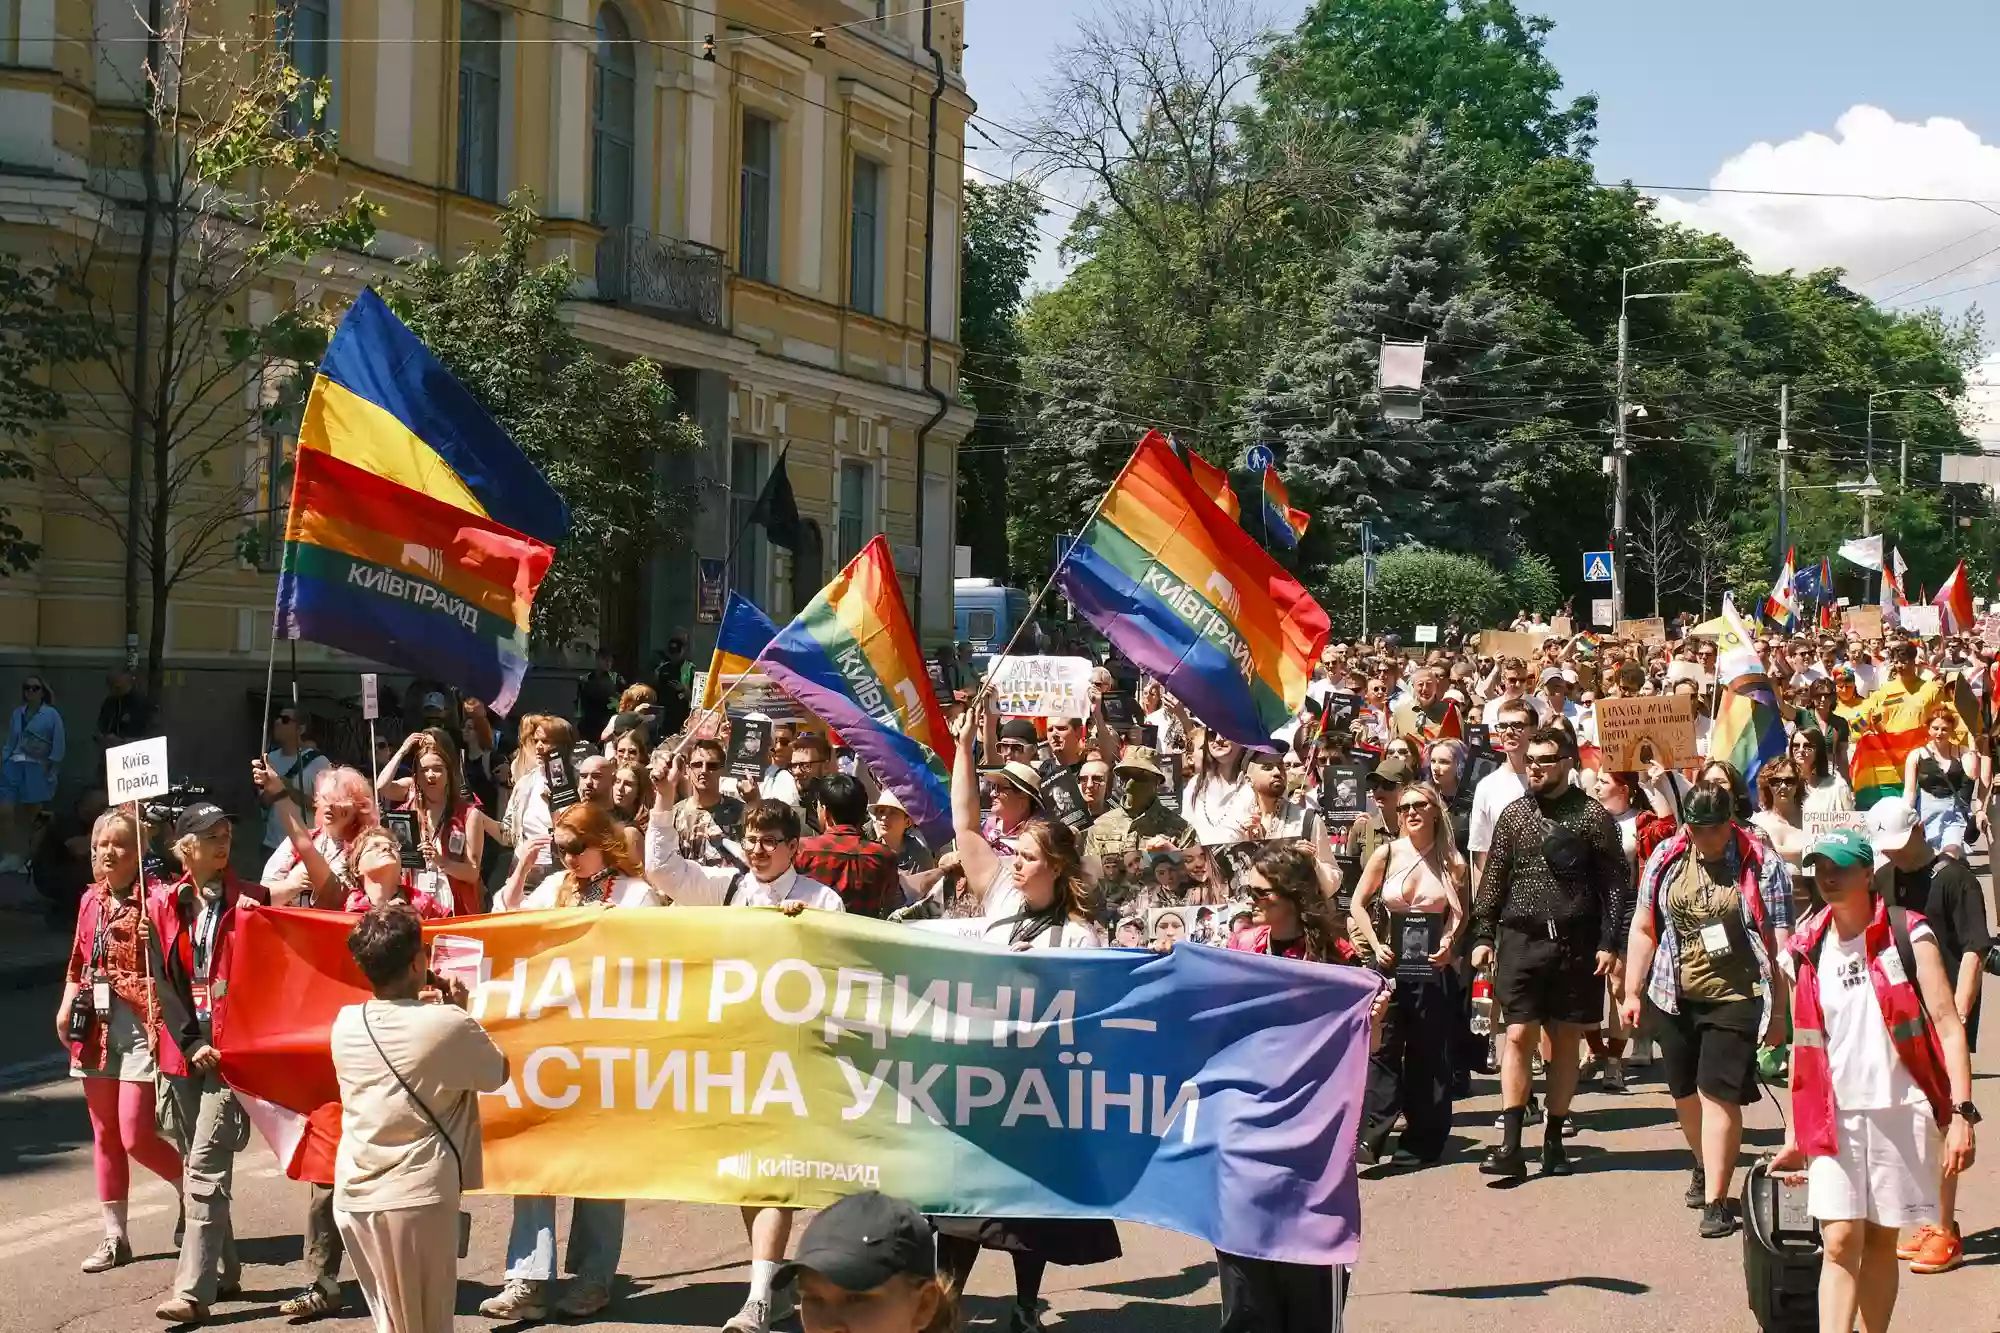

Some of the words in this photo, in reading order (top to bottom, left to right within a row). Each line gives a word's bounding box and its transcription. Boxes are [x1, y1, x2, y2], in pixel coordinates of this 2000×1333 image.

[347, 562, 479, 634] КИЇВПРАЙД
[1143, 566, 1256, 686] КИЇВПРАЙД
[1008, 660, 1070, 681] MAKE
[116, 772, 159, 793] Прайд
[121, 752, 150, 770] Київ
[470, 955, 683, 1021] НАШІ
[708, 958, 1076, 1050] РОДИНИ
[836, 1051, 1200, 1144] УКРАЇНИ
[756, 1152, 880, 1187] КИЇВПРАЙД
